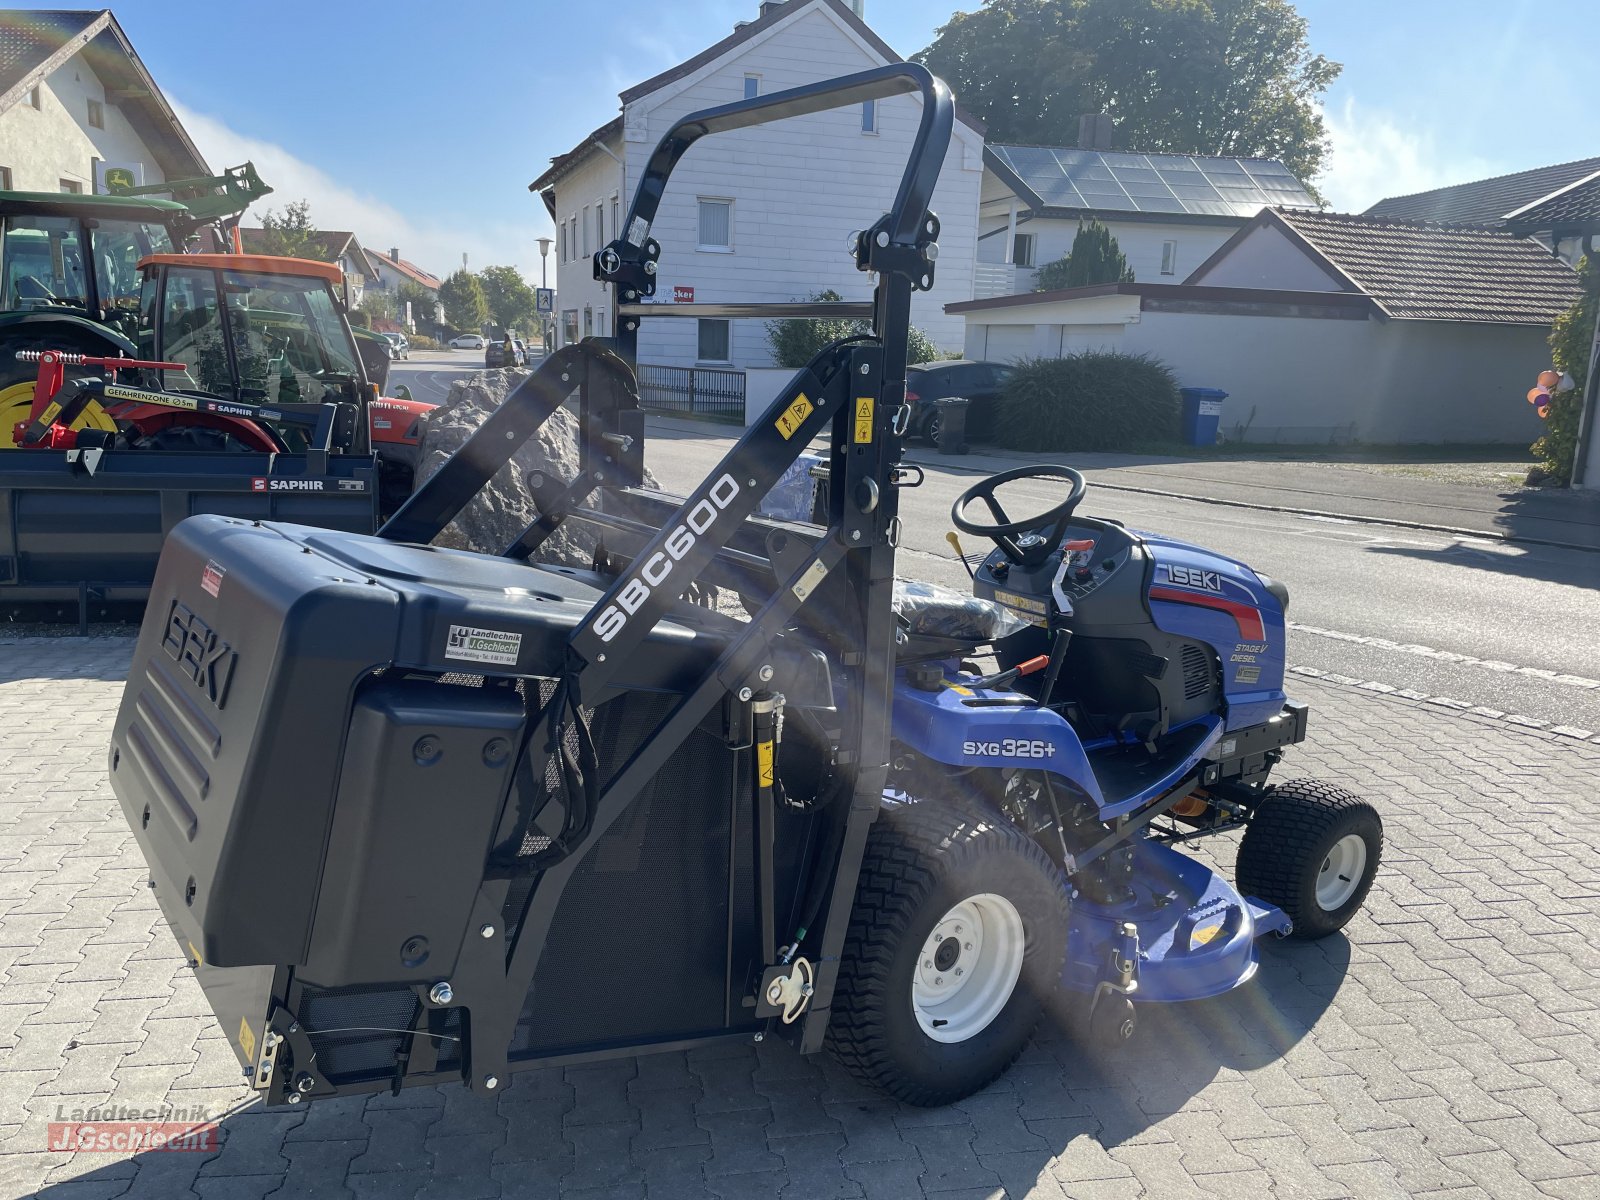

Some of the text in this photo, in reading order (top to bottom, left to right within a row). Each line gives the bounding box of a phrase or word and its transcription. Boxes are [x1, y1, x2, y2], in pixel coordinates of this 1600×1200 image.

[107, 388, 170, 404] GEFAHRENZONE
[217, 405, 253, 416] SAPHIR
[270, 480, 324, 490] SAPHIR
[592, 473, 740, 643] SBC600
[1167, 564, 1221, 591] ISEKI
[471, 629, 521, 641] Landtechnik
[470, 640, 518, 653] J.Gschlecht
[1235, 644, 1260, 653] STAGE
[1229, 654, 1256, 663] DIESEL
[962, 738, 1056, 758] SXG 326+
